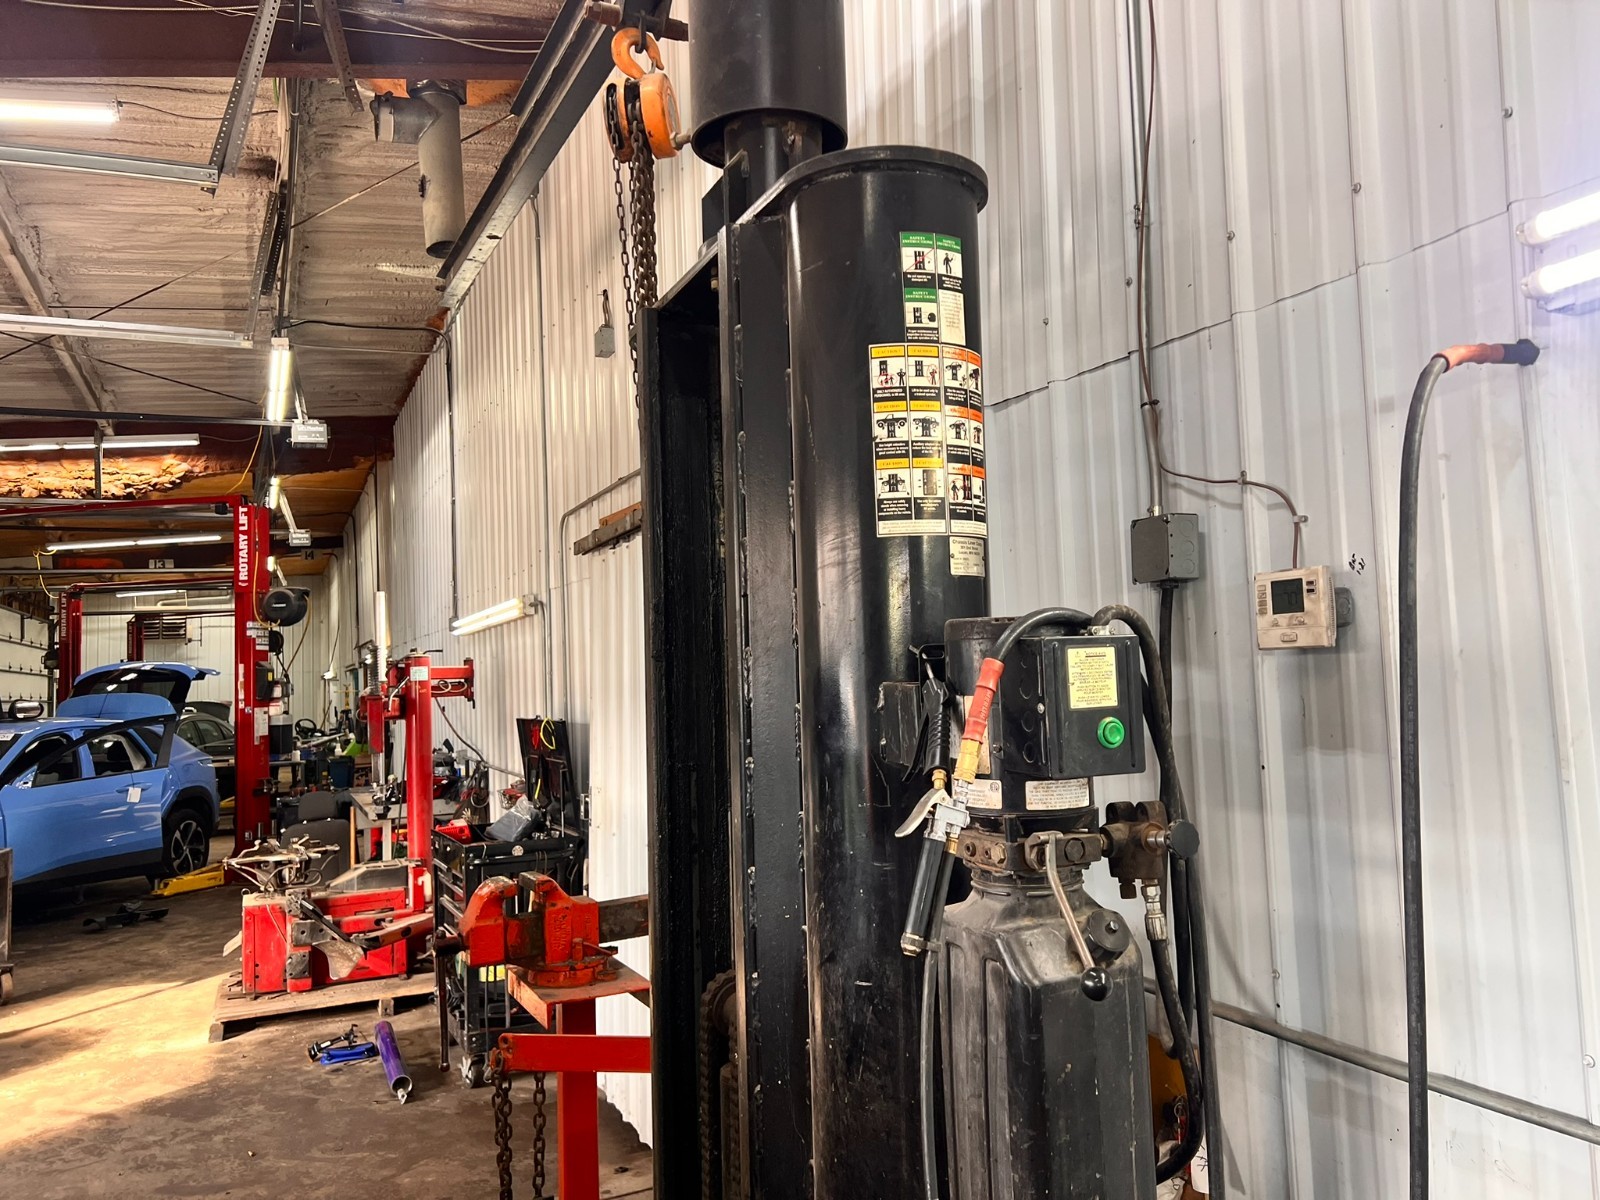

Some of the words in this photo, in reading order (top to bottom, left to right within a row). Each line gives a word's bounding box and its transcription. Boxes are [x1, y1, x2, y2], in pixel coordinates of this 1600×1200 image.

[239, 506, 248, 530] LIFT
[239, 533, 248, 580] ROTARY
[304, 551, 314, 560] 14
